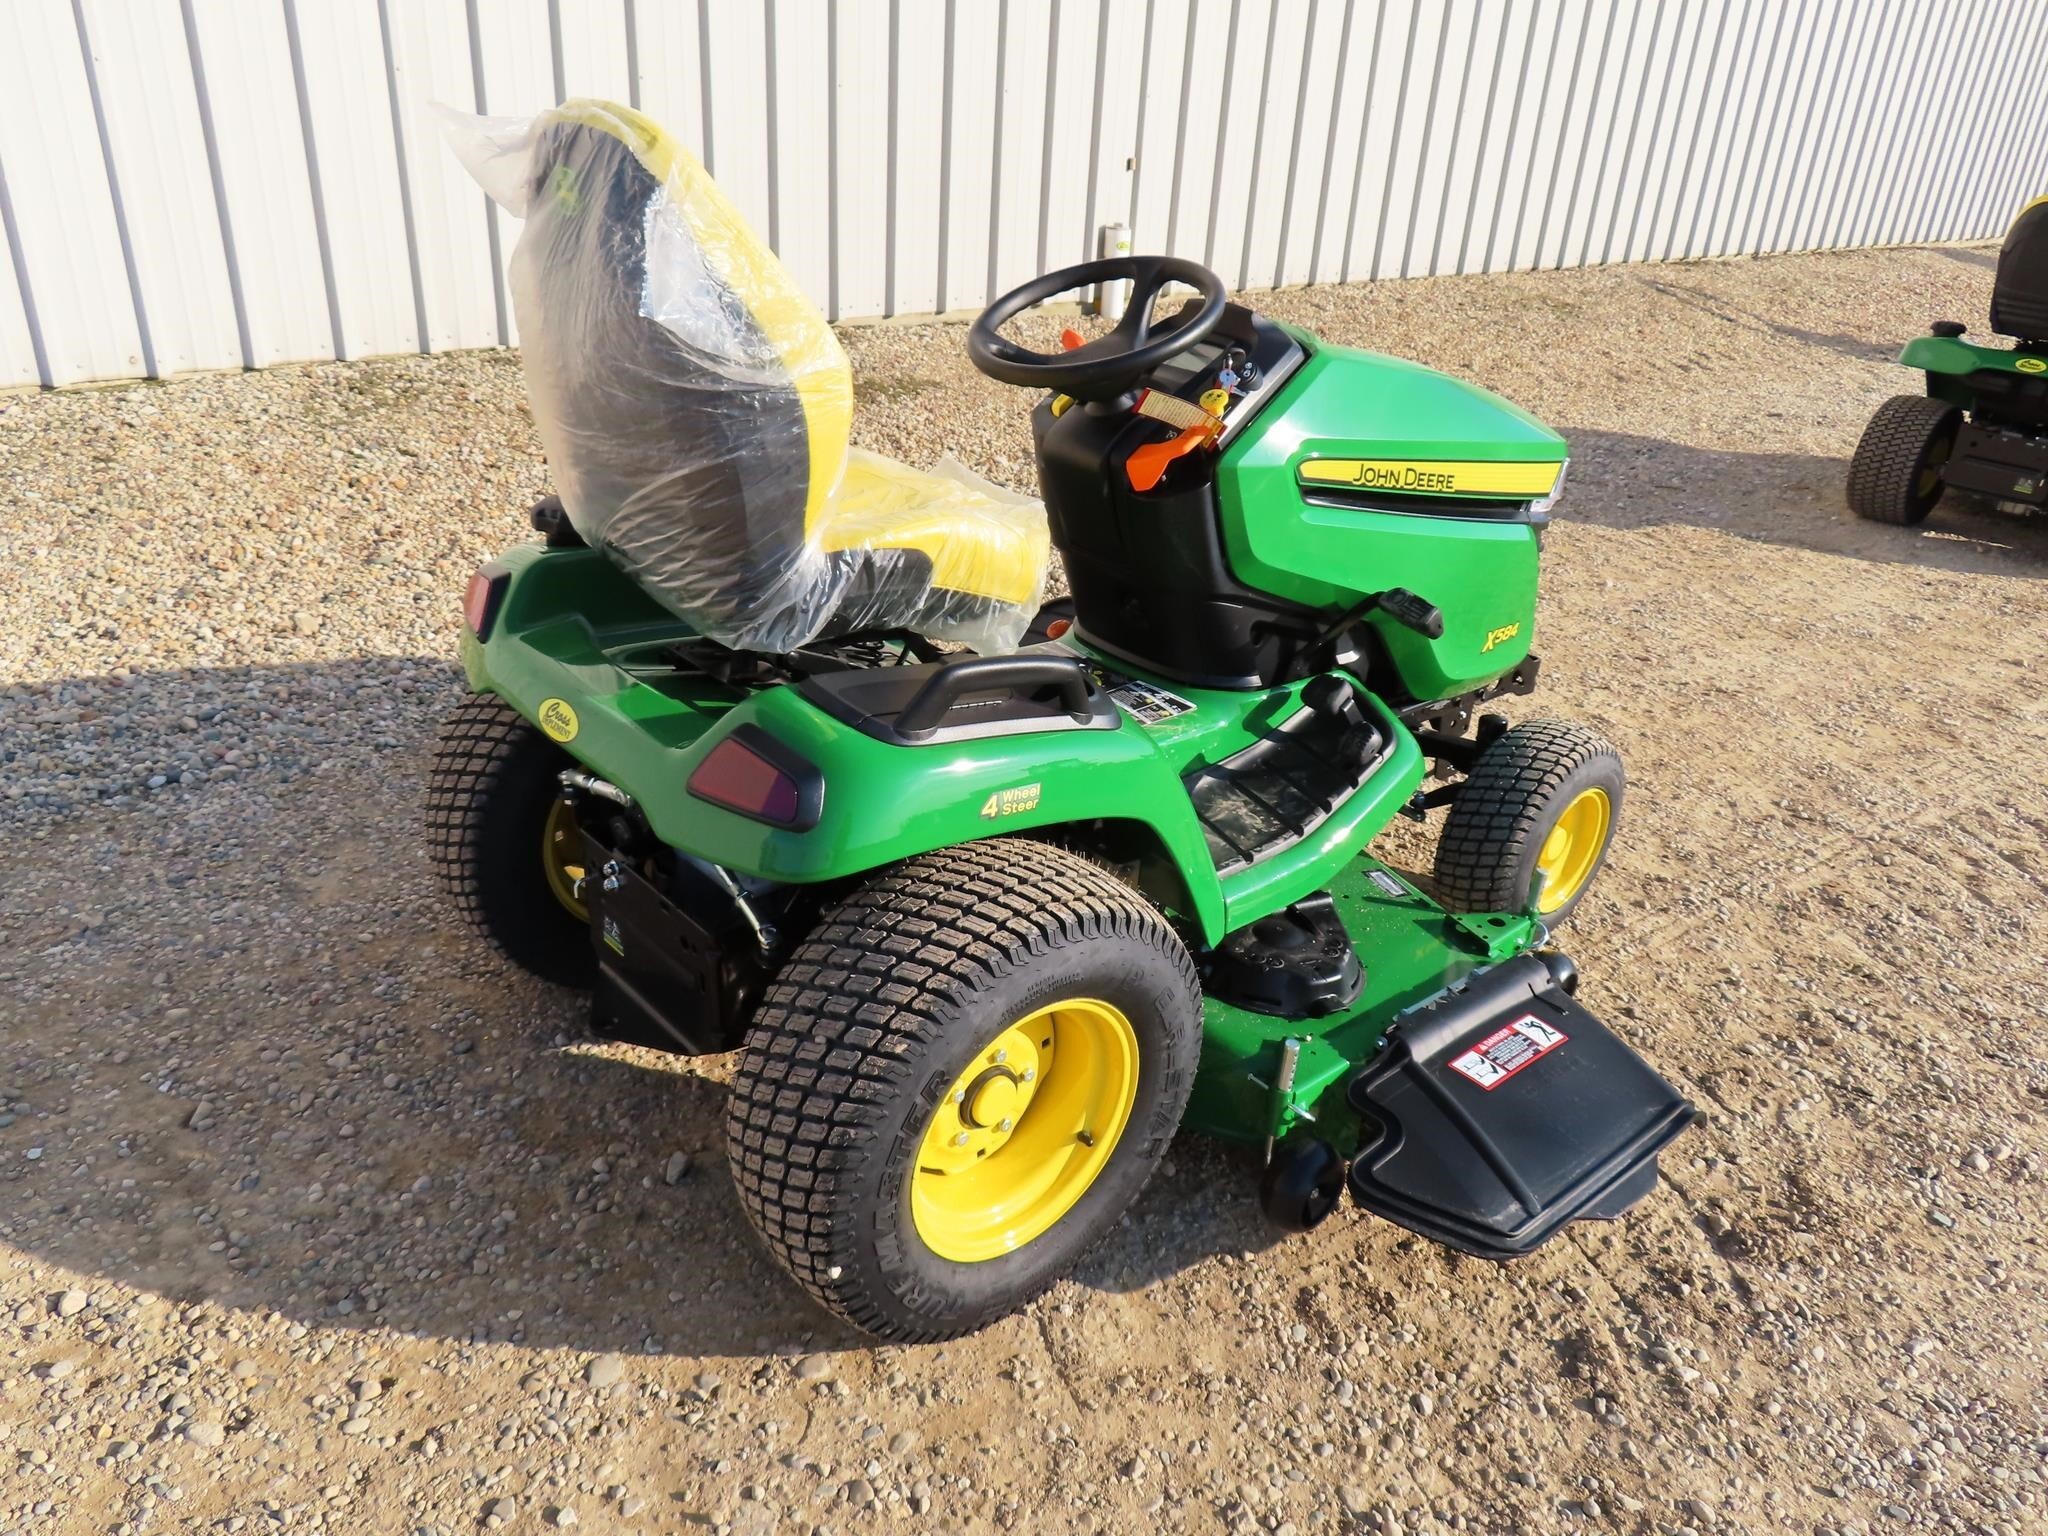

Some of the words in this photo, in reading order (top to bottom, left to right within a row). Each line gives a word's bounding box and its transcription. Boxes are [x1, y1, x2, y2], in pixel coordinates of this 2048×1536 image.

[1353, 464, 1400, 484] JOHN
[1404, 468, 1455, 489] DEERE
[1481, 622, 1520, 654] X584
[1003, 784, 1040, 802] Wheel
[981, 794, 998, 817] 4
[1002, 800, 1039, 815] Steer
[1484, 1028, 1511, 1047] DANGER
